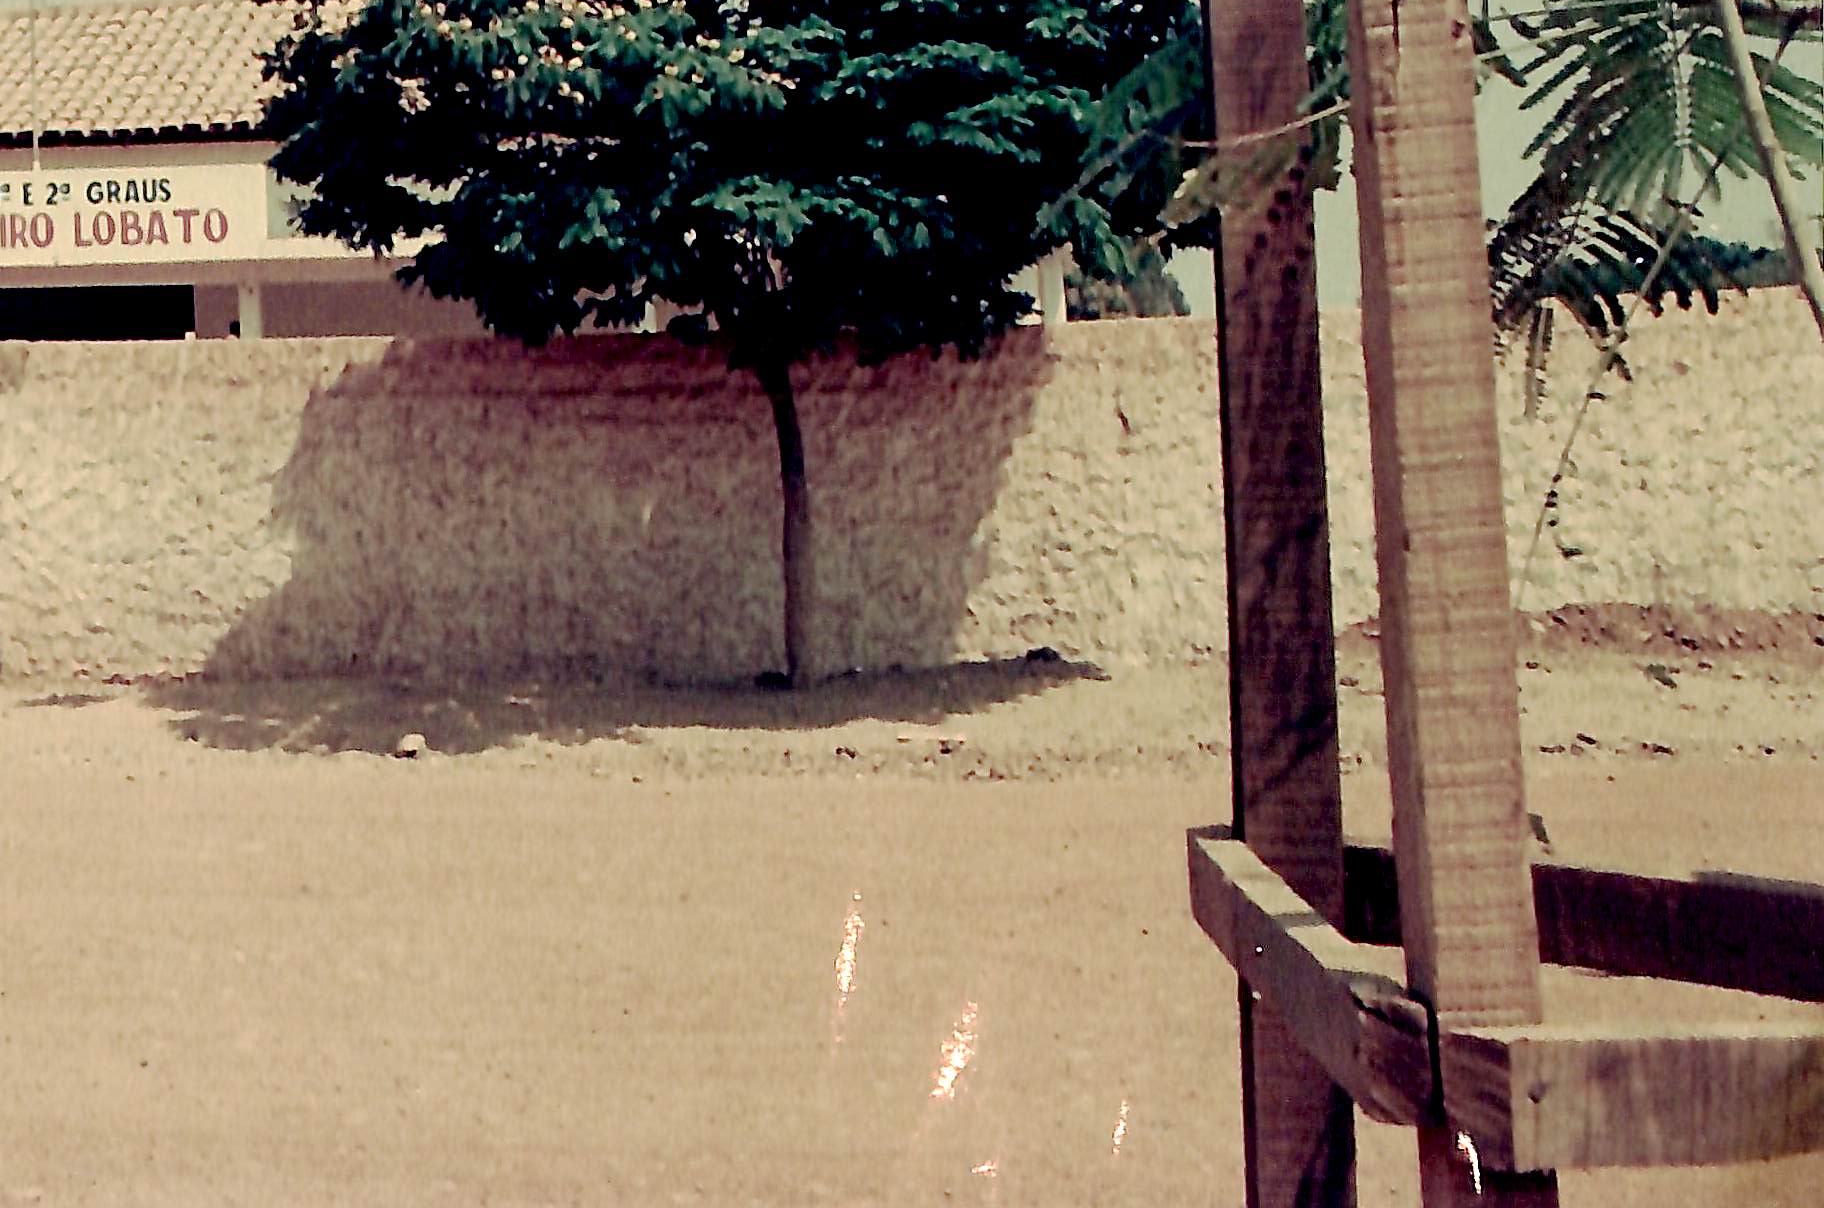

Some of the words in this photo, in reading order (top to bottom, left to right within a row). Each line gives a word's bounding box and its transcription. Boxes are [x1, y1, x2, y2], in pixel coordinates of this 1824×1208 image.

[22, 182, 34, 206] E
[86, 178, 172, 205] GRAUS
[74, 207, 229, 248] LOBATO
